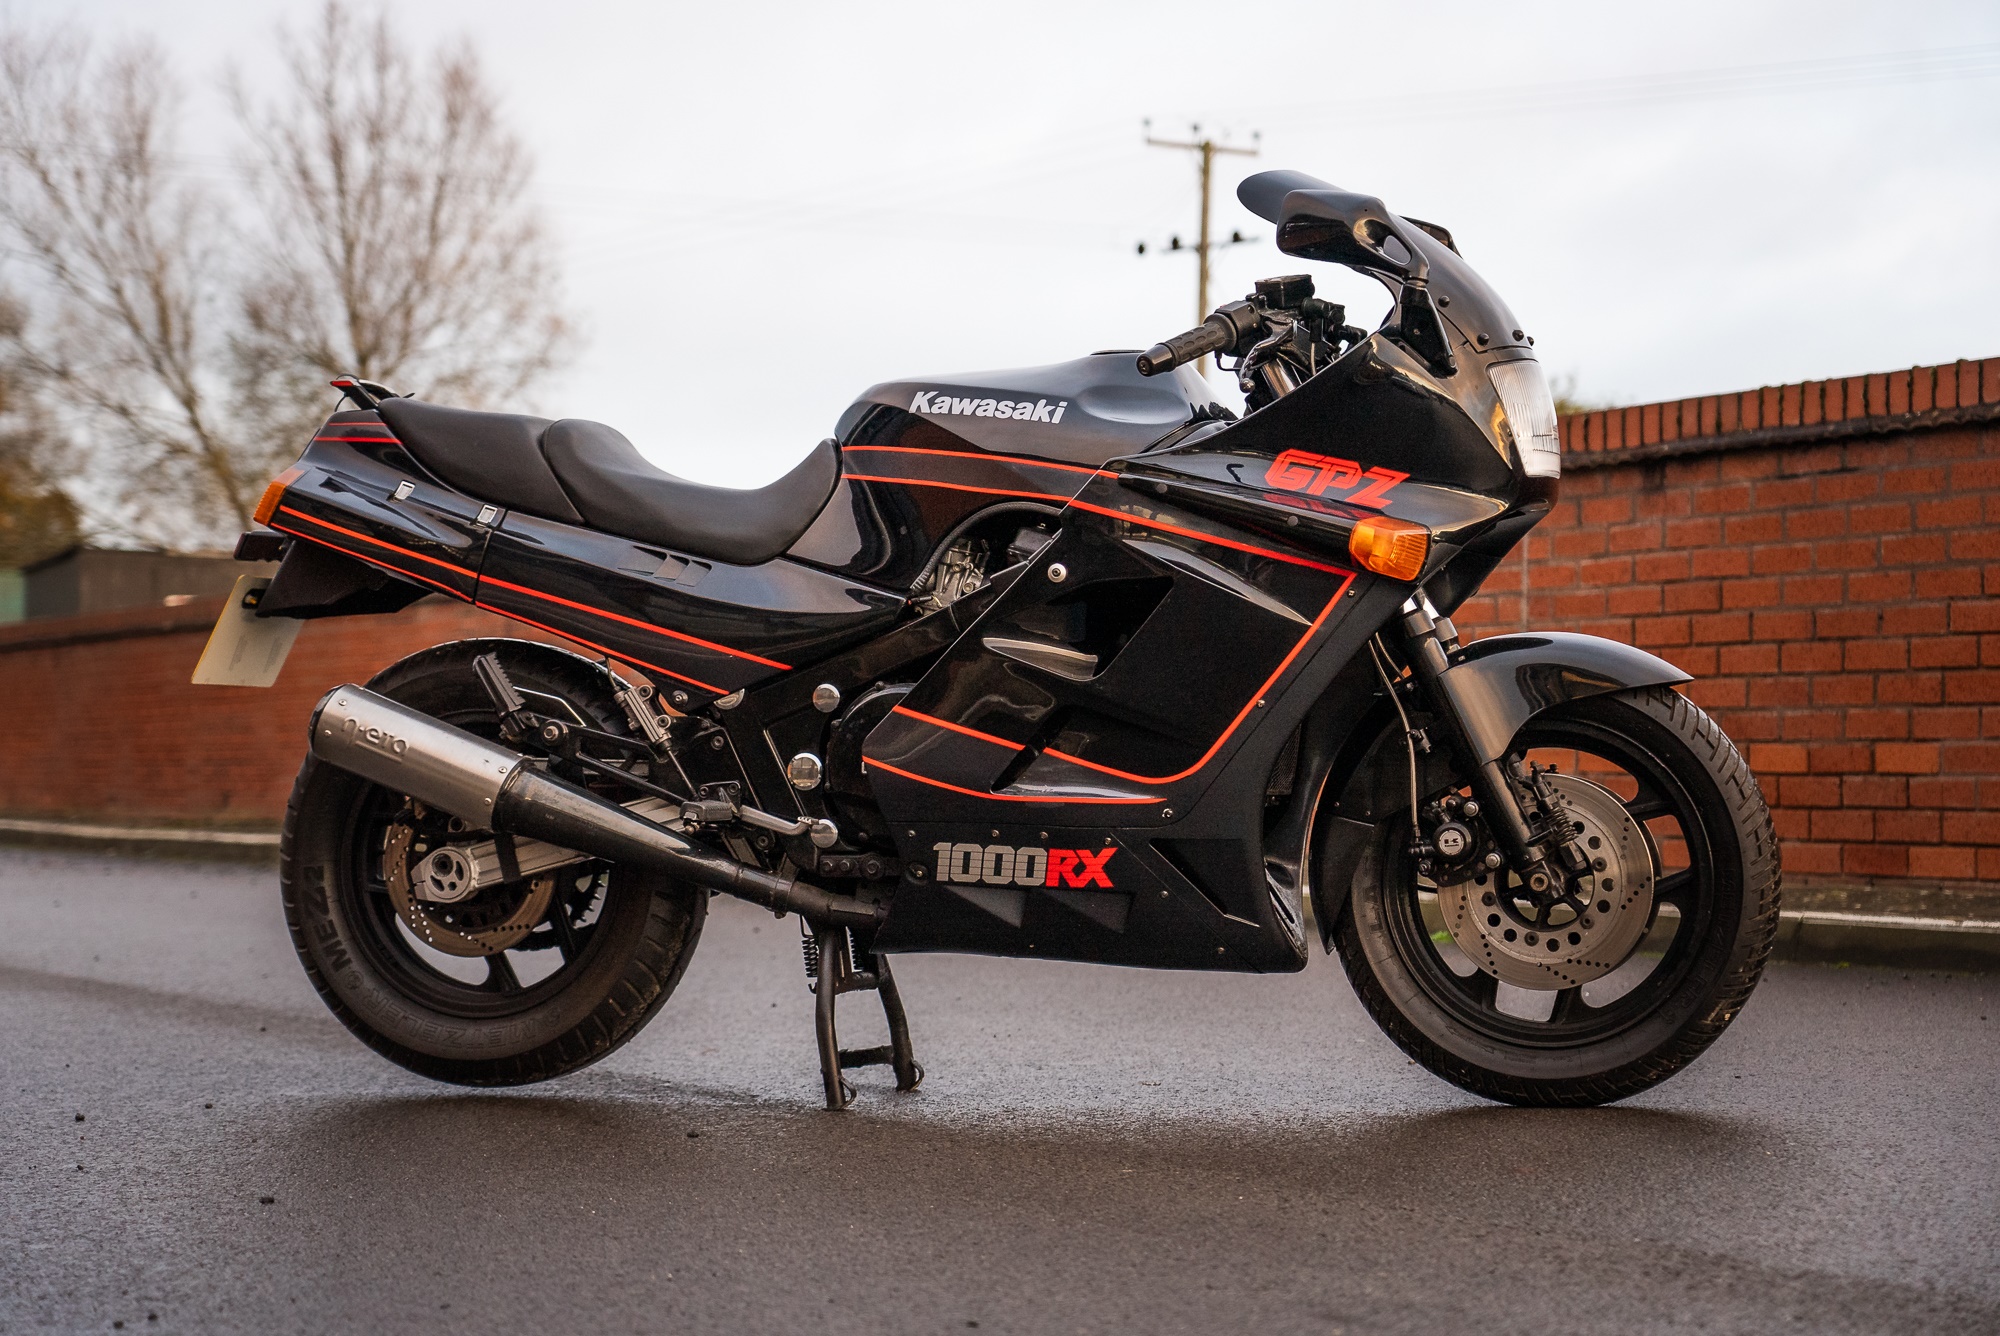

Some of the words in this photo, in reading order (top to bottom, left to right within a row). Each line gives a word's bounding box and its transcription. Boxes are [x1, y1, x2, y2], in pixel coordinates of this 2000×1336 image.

[908, 390, 1068, 425] Kawasaki
[1264, 448, 1411, 510] GPZ
[932, 841, 1119, 889] 1000RX
